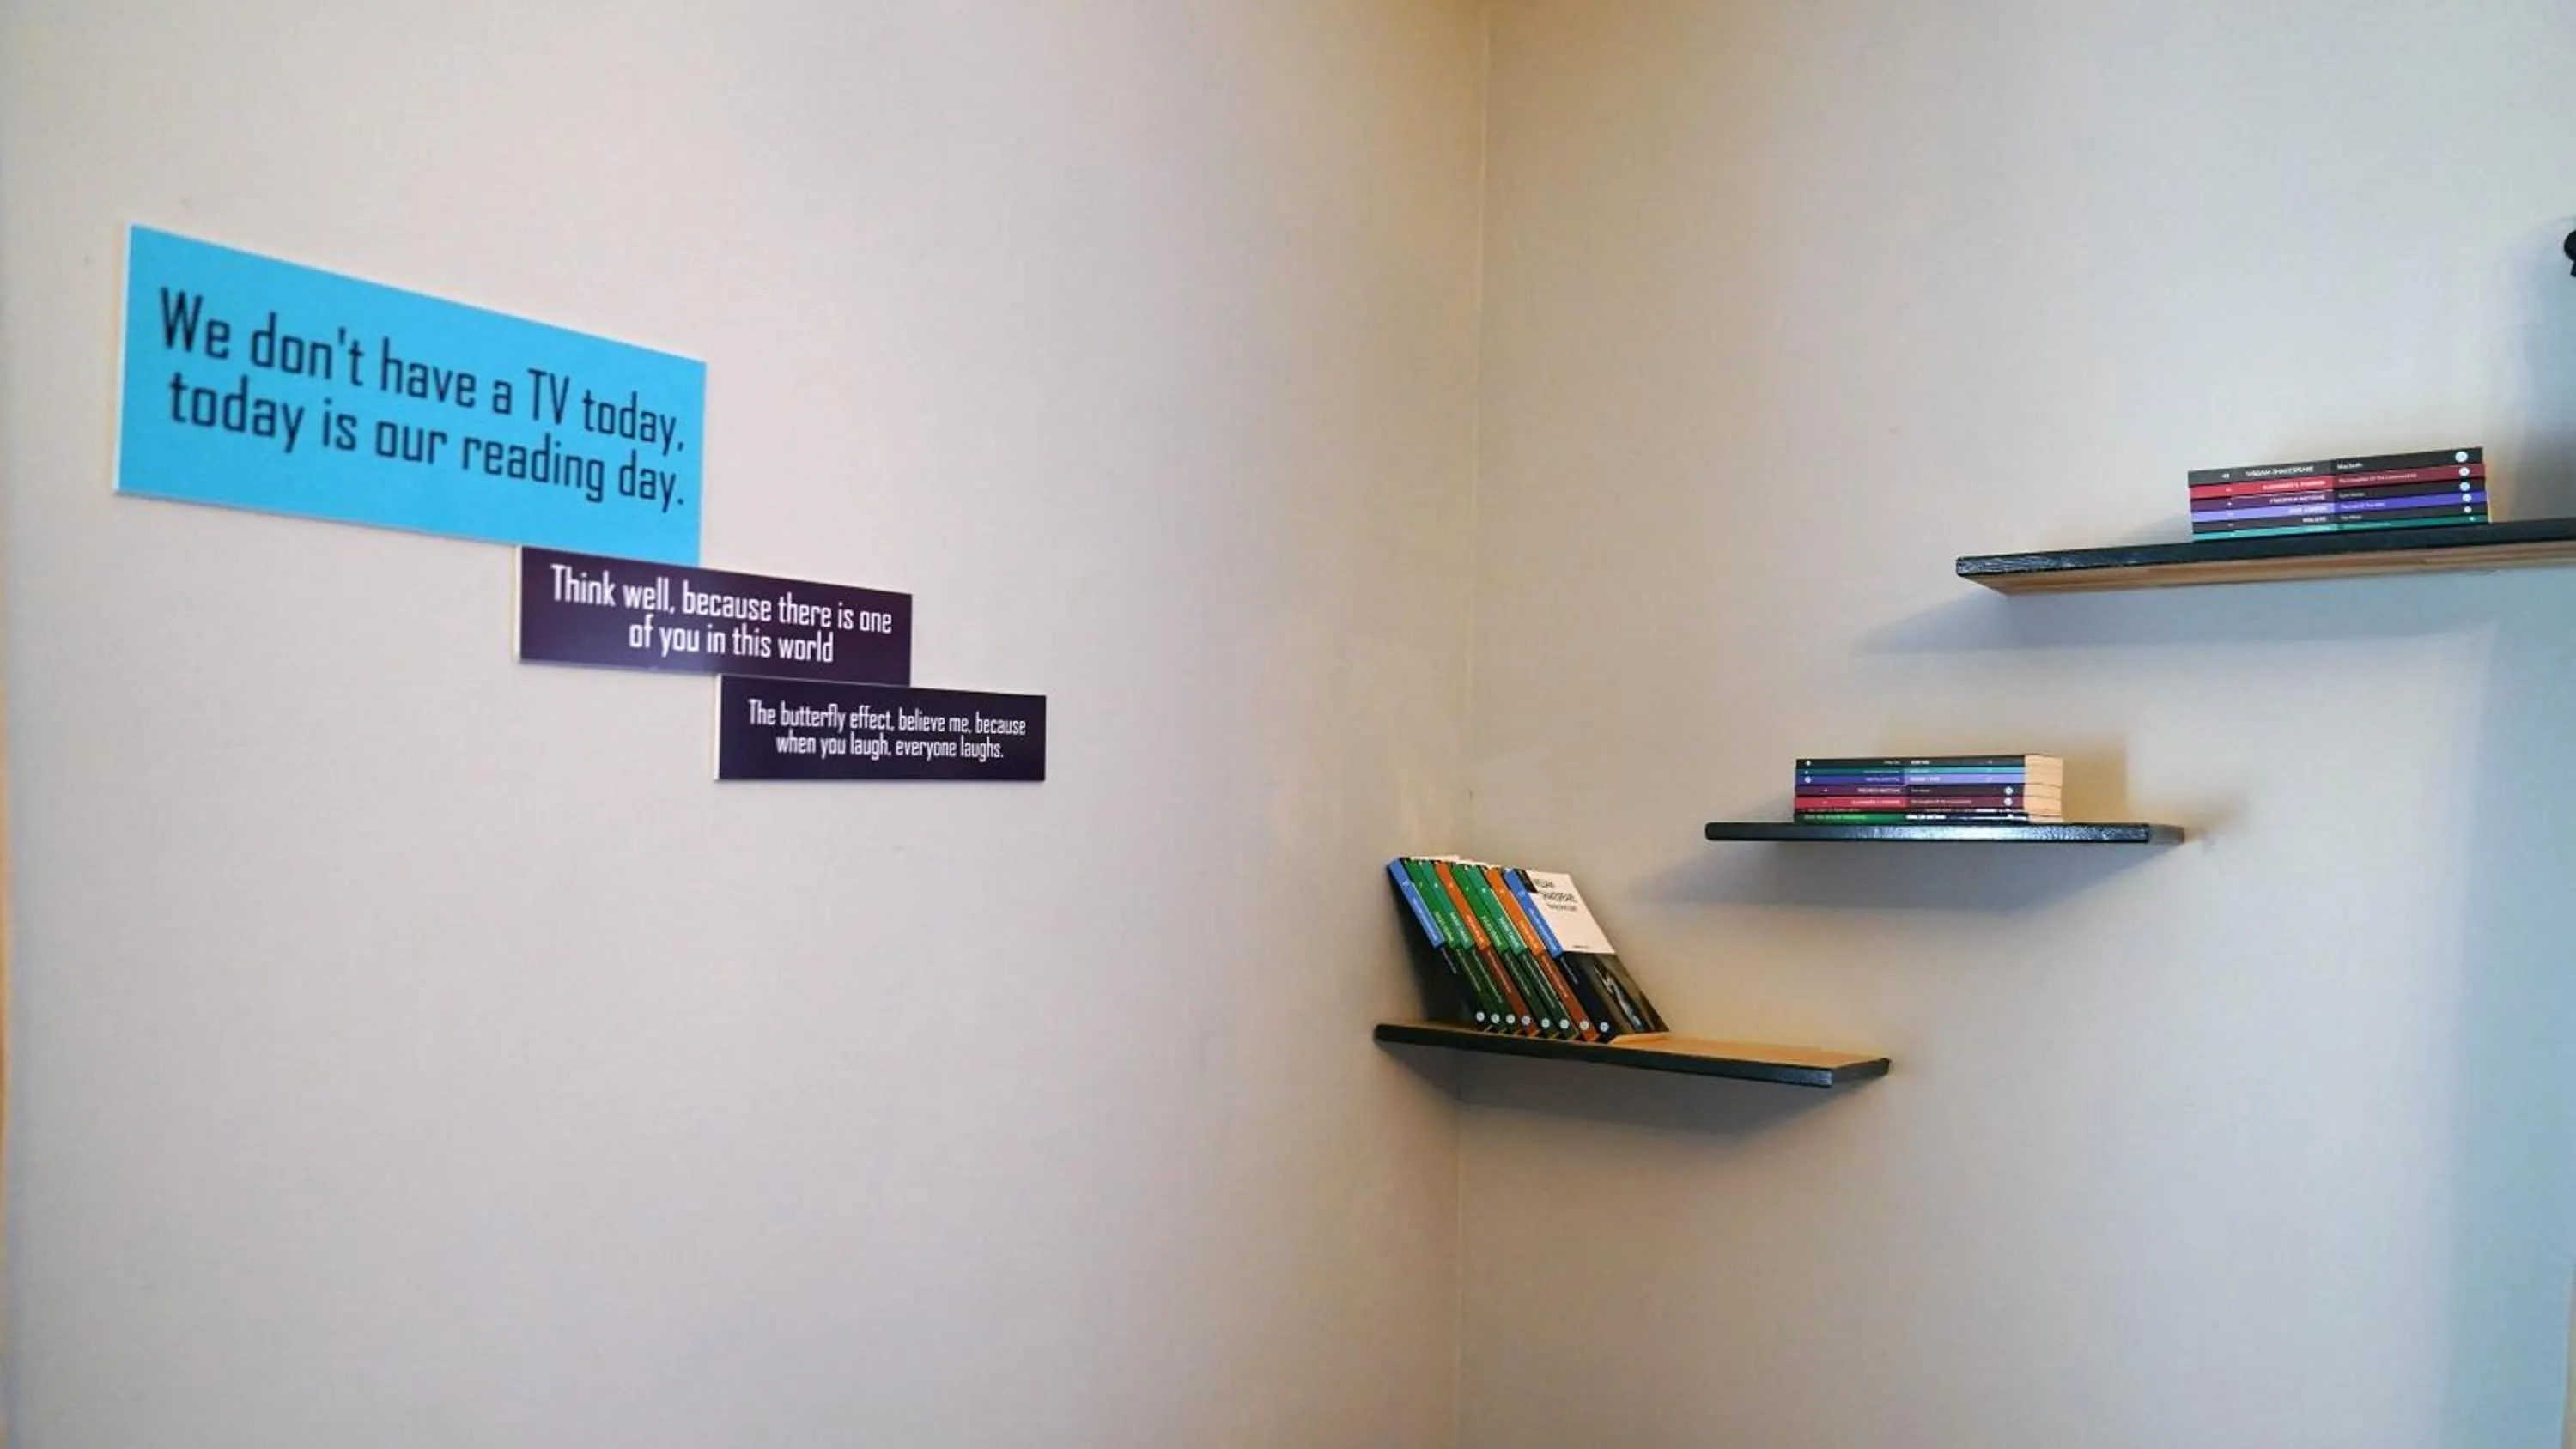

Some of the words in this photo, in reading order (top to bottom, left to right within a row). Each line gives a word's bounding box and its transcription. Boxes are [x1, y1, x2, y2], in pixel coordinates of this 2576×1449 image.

[161, 287, 231, 361] We
[249, 311, 364, 388] don't
[379, 336, 477, 409] have
[490, 377, 513, 415] a
[526, 367, 571, 426] TV
[580, 390, 686, 457] today,
[167, 371, 306, 454] today
[321, 397, 358, 451] is
[374, 419, 447, 464] our
[461, 433, 605, 504] reading
[617, 449, 686, 515] day.
[550, 563, 617, 608] Think
[622, 577, 676, 615] well,
[683, 579, 772, 623] because
[778, 595, 831, 629] there
[838, 601, 854, 631] is
[860, 613, 892, 634] one
[629, 614, 654, 650] of
[659, 627, 700, 660] you
[707, 625, 726, 654] in
[731, 627, 771, 658] this
[777, 631, 834, 663] world
[748, 698, 775, 726] The
[780, 700, 846, 731] butterfly
[898, 707, 945, 732] believe
[975, 711, 1027, 737] because
[775, 730, 816, 755] when
[820, 737, 846, 759] you
[896, 739, 957, 762] everyone
[960, 735, 1004, 763] laughs.
